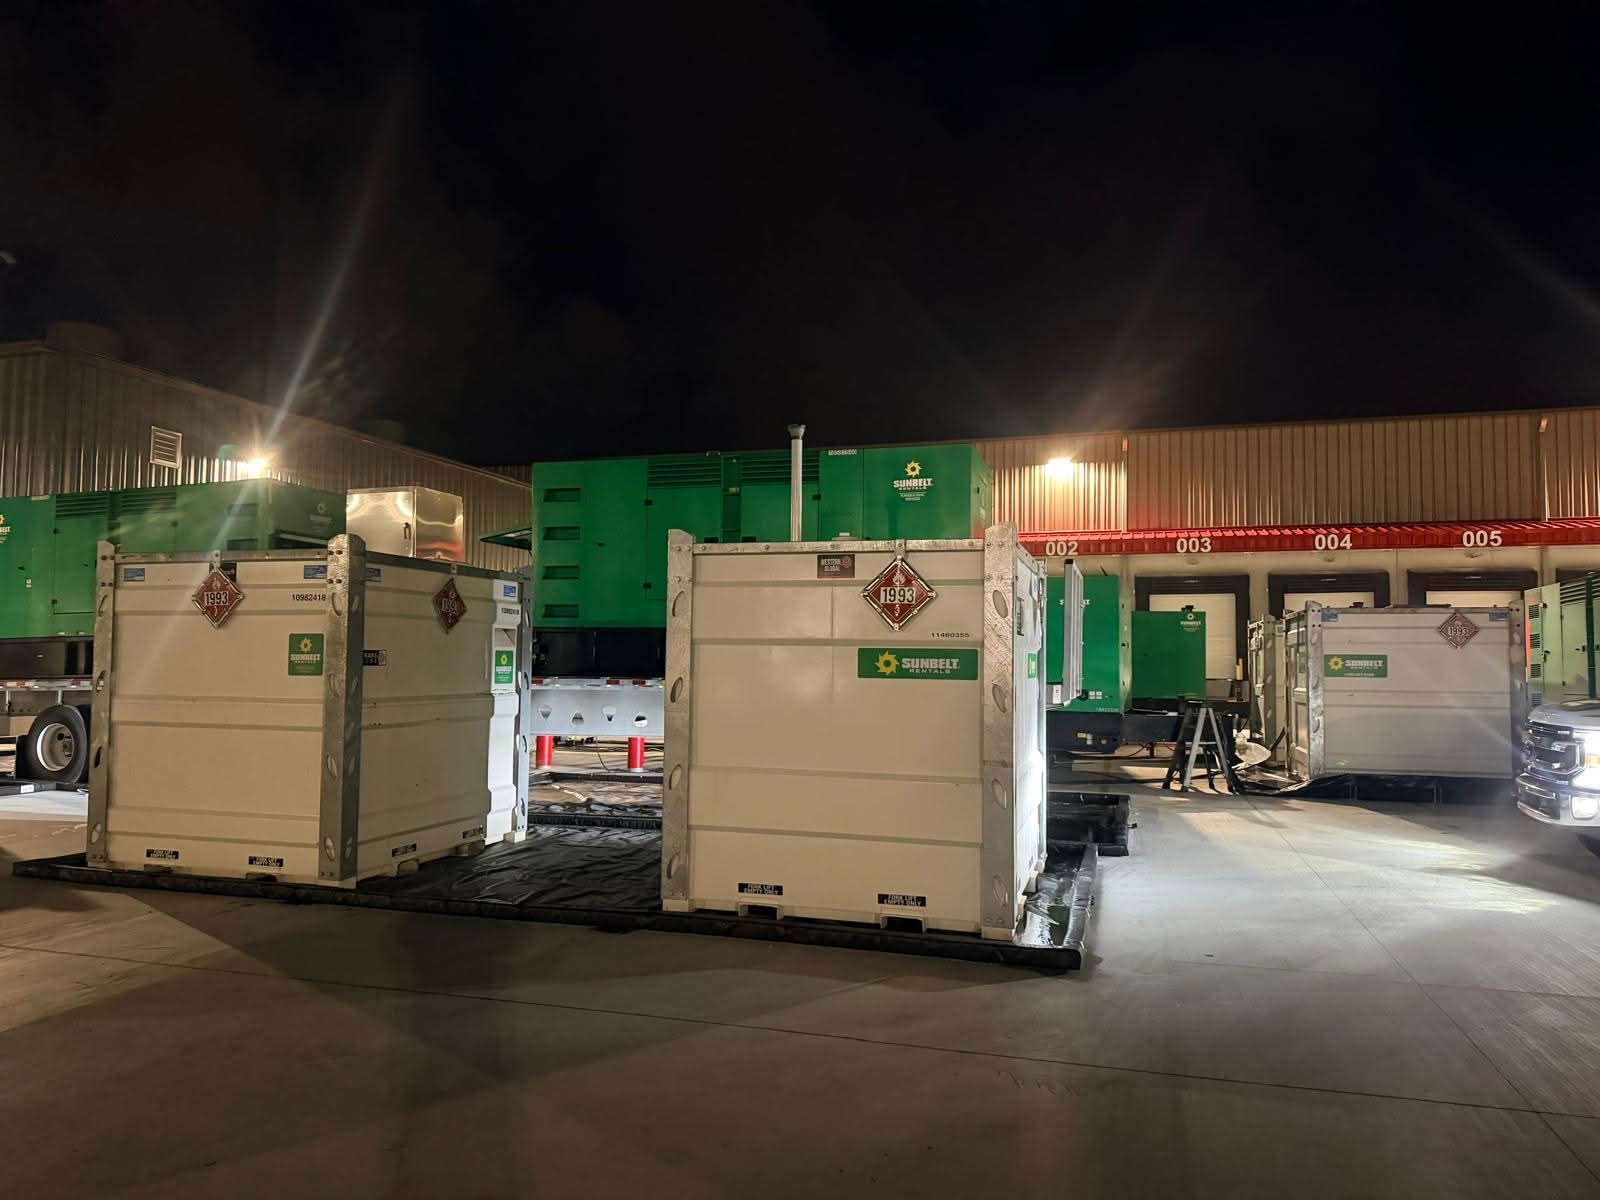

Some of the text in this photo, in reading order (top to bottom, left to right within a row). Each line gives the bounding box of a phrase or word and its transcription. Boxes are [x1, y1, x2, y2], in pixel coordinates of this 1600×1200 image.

[893, 478, 932, 488] SUNBELT
[1176, 537, 1212, 553] 003
[1314, 534, 1352, 550] 004
[1462, 531, 1502, 547] 005
[1045, 541, 1079, 556] 002
[205, 591, 228, 605] 1993
[883, 587, 915, 603] 1993
[894, 604, 901, 616] 3
[1448, 627, 1469, 636] 1993
[290, 653, 321, 661] SUNBELT
[901, 657, 960, 669] SUNBELT
